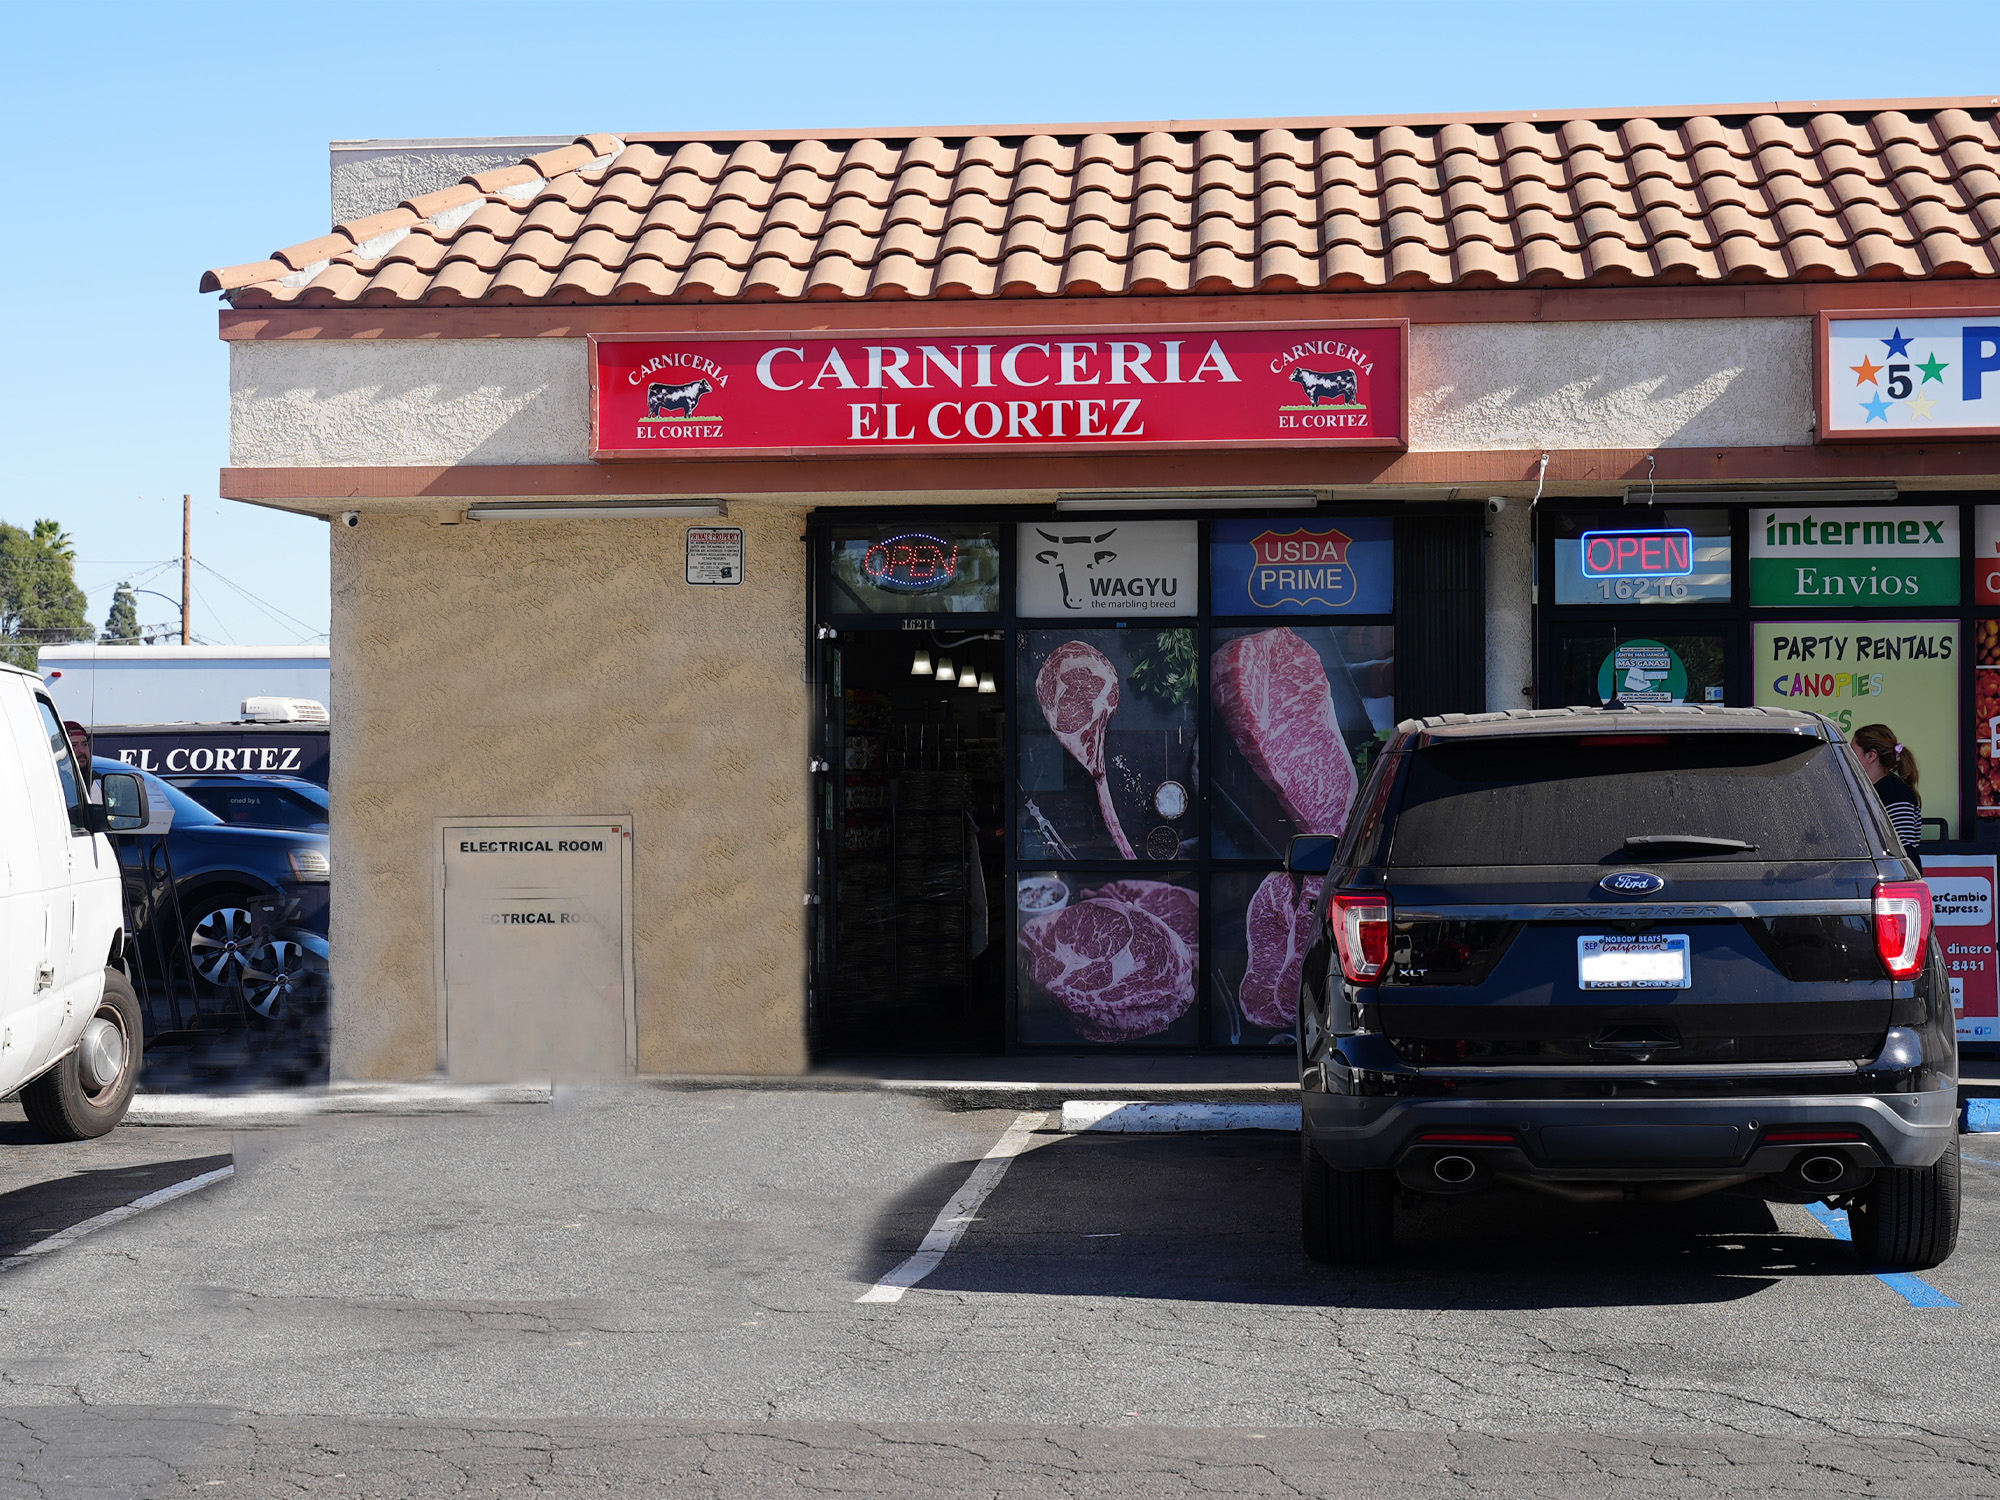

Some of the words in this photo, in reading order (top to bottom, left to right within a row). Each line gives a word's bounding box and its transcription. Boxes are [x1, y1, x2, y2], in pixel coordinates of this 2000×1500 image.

[756, 338, 1242, 391] CARNICERIA
[1269, 340, 1374, 377] CARNICERIA
[628, 352, 730, 388] CARNICERIA
[1887, 364, 1913, 400] 5
[847, 403, 915, 440] EL
[928, 398, 1145, 440] CORTEZ
[1278, 415, 1299, 428] EL
[1302, 413, 1368, 428] CORTEZ
[636, 426, 656, 439] EL
[659, 425, 723, 439] CORTEZ
[1766, 512, 1945, 546] intermex
[864, 545, 958, 577] OPEN
[1265, 541, 1338, 562] USDA
[1587, 537, 1689, 571] OPEN
[1089, 578, 1177, 596] WAGYU
[1261, 569, 1342, 590] PRIME
[1597, 577, 1688, 599] 16216
[1794, 566, 1919, 595] Envios
[1091, 600, 1106, 608] the
[1109, 600, 1148, 610] marbling
[1150, 600, 1176, 608] breed
[902, 619, 936, 630] 16214
[1773, 636, 1848, 661] PARTY
[1856, 635, 1953, 661] RENTALS
[1773, 673, 1884, 697] CANOPIES
[118, 749, 159, 771] EL
[166, 747, 302, 772] CORTEZ
[460, 841, 553, 852] ELECTRICAL
[558, 841, 603, 852] ROOM
[1614, 875, 1649, 889] Ford
[1932, 892, 1988, 902] erCambio
[1549, 906, 1720, 917] EXPLORER
[1585, 942, 1598, 951] SEP
[1947, 943, 1992, 954] dinero
[1399, 969, 1428, 977] XLT
[1947, 960, 1985, 971] -8441
